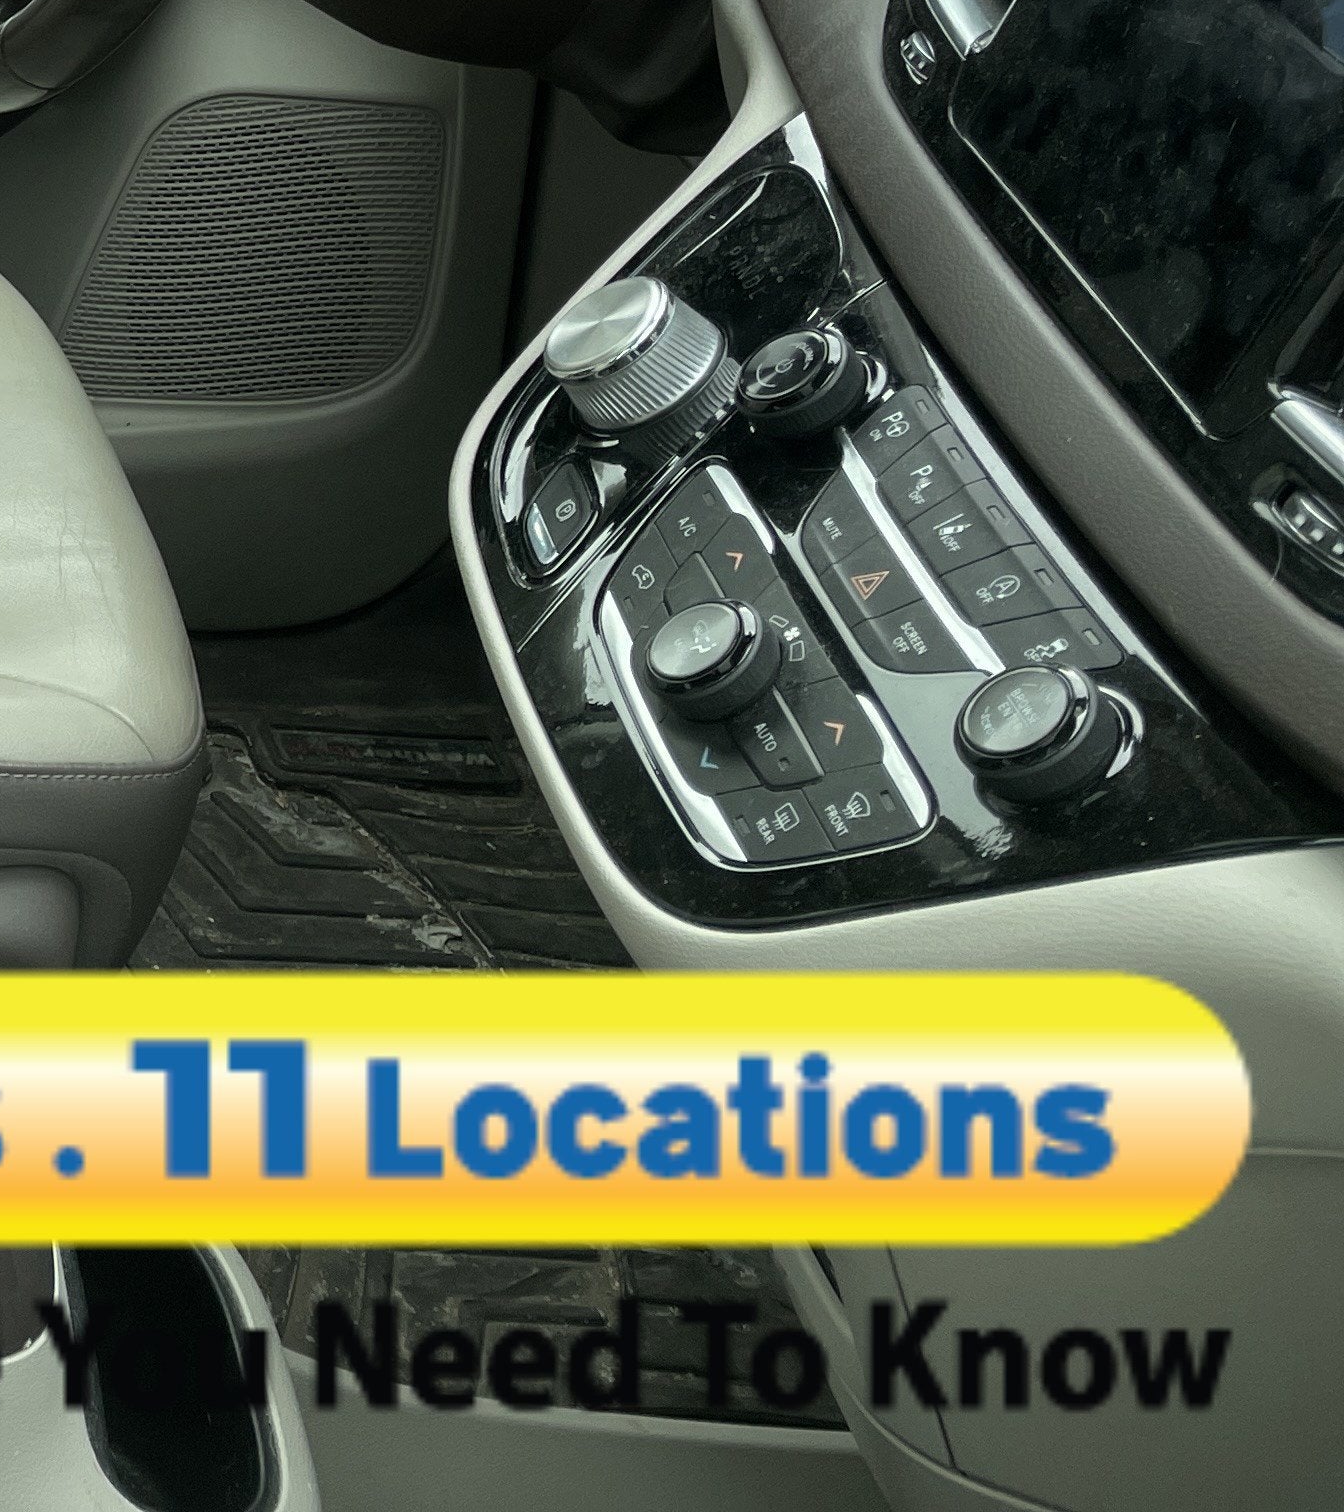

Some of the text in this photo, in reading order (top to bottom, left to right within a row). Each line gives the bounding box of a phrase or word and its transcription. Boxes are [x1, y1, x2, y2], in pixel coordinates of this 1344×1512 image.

[677, 515, 698, 538] A/C
[821, 516, 844, 540] MUTE
[975, 587, 995, 605] OFF
[892, 635, 911, 654] OFF
[900, 621, 928, 656] SCREEN
[753, 722, 778, 753] AUTO
[755, 817, 776, 846] REAR
[823, 804, 850, 837] FRONT
